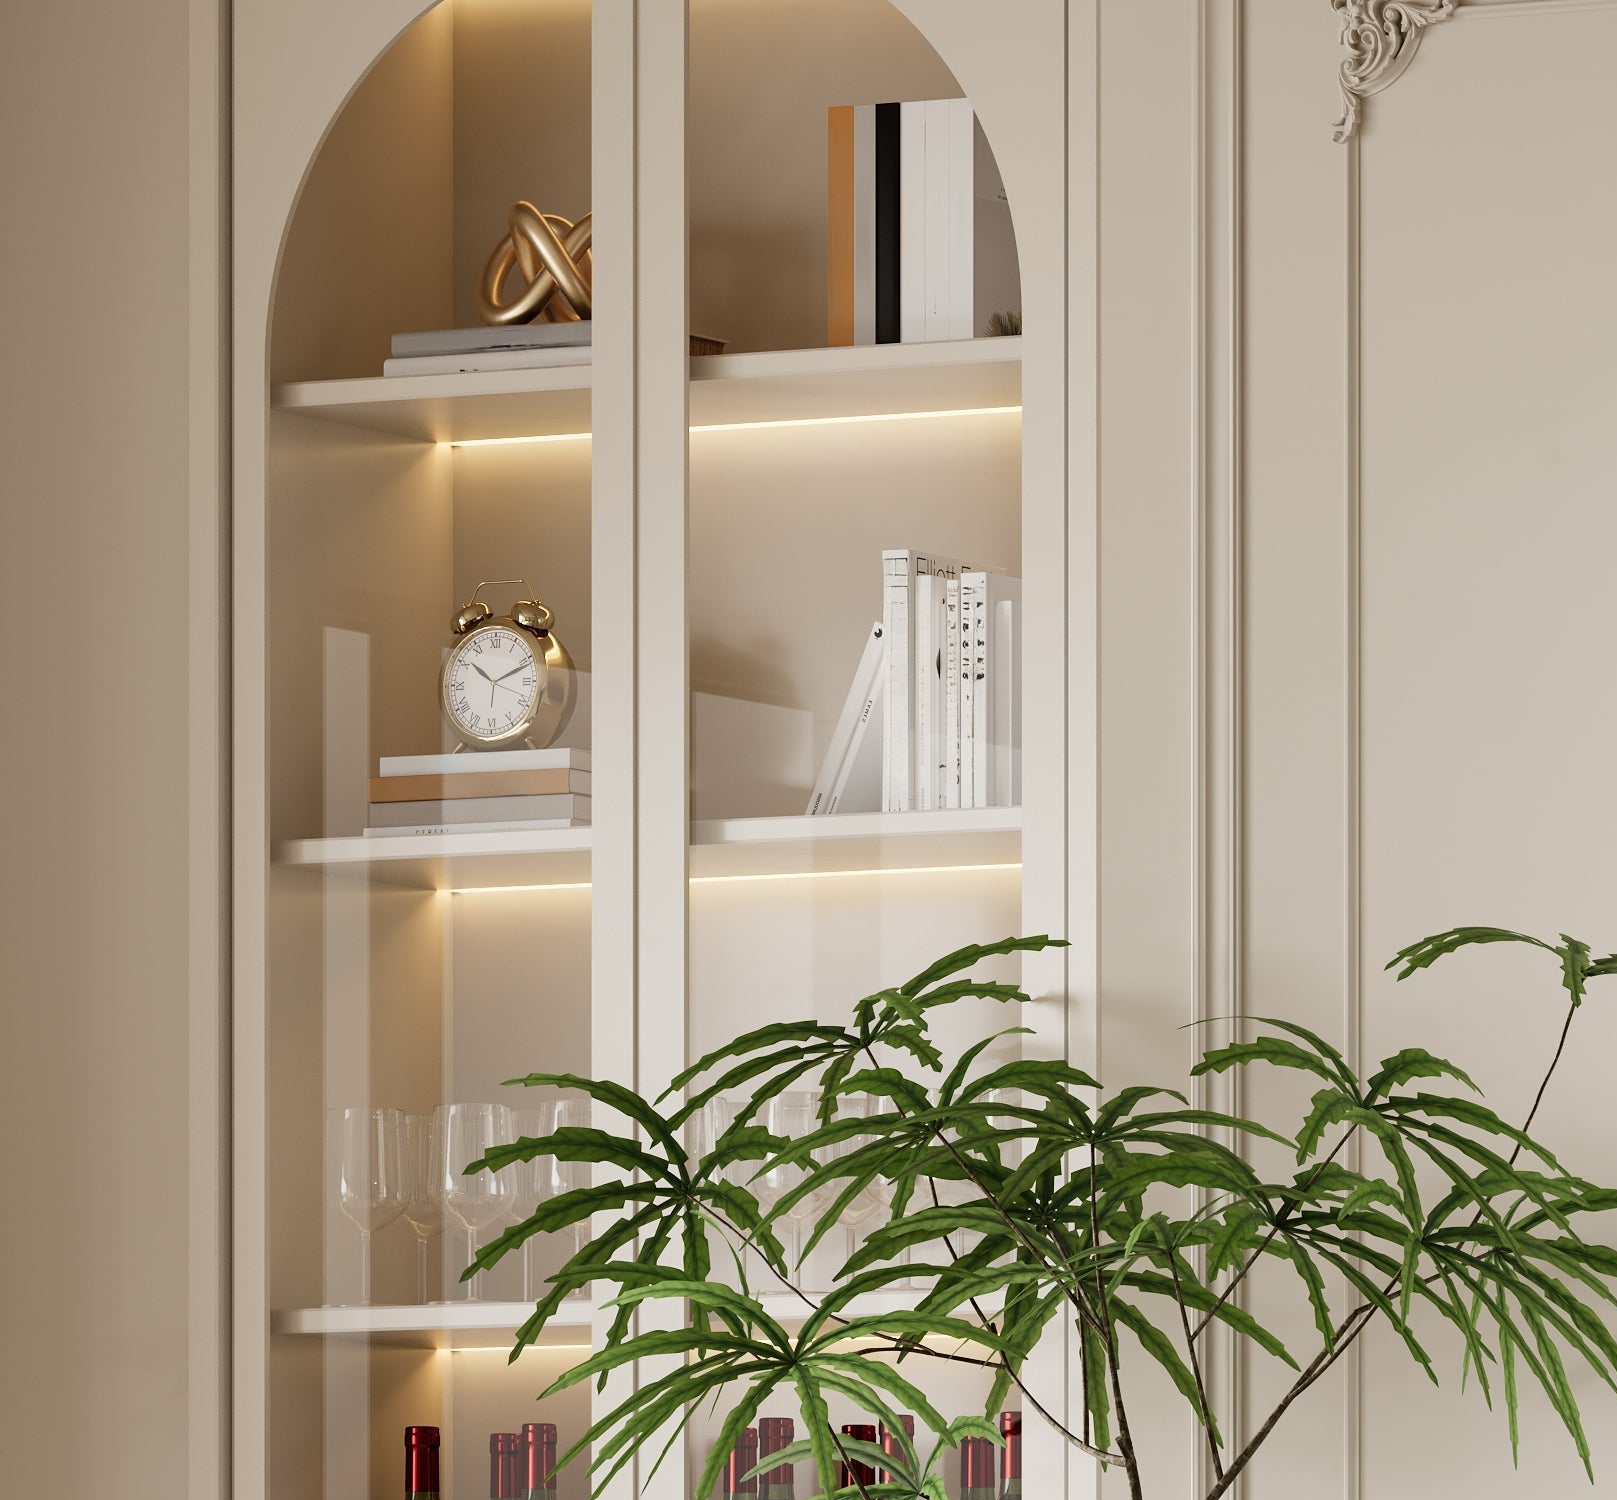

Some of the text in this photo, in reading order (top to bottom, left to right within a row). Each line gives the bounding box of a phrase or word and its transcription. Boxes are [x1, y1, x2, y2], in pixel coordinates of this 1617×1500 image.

[490, 638, 501, 649] XII
[472, 644, 483, 656] XI
[460, 660, 470, 670] X
[456, 681, 465, 691] IX
[522, 677, 532, 686] III
[458, 696, 471, 714] VIII
[470, 712, 481, 725] VII
[487, 718, 497, 728] VI
